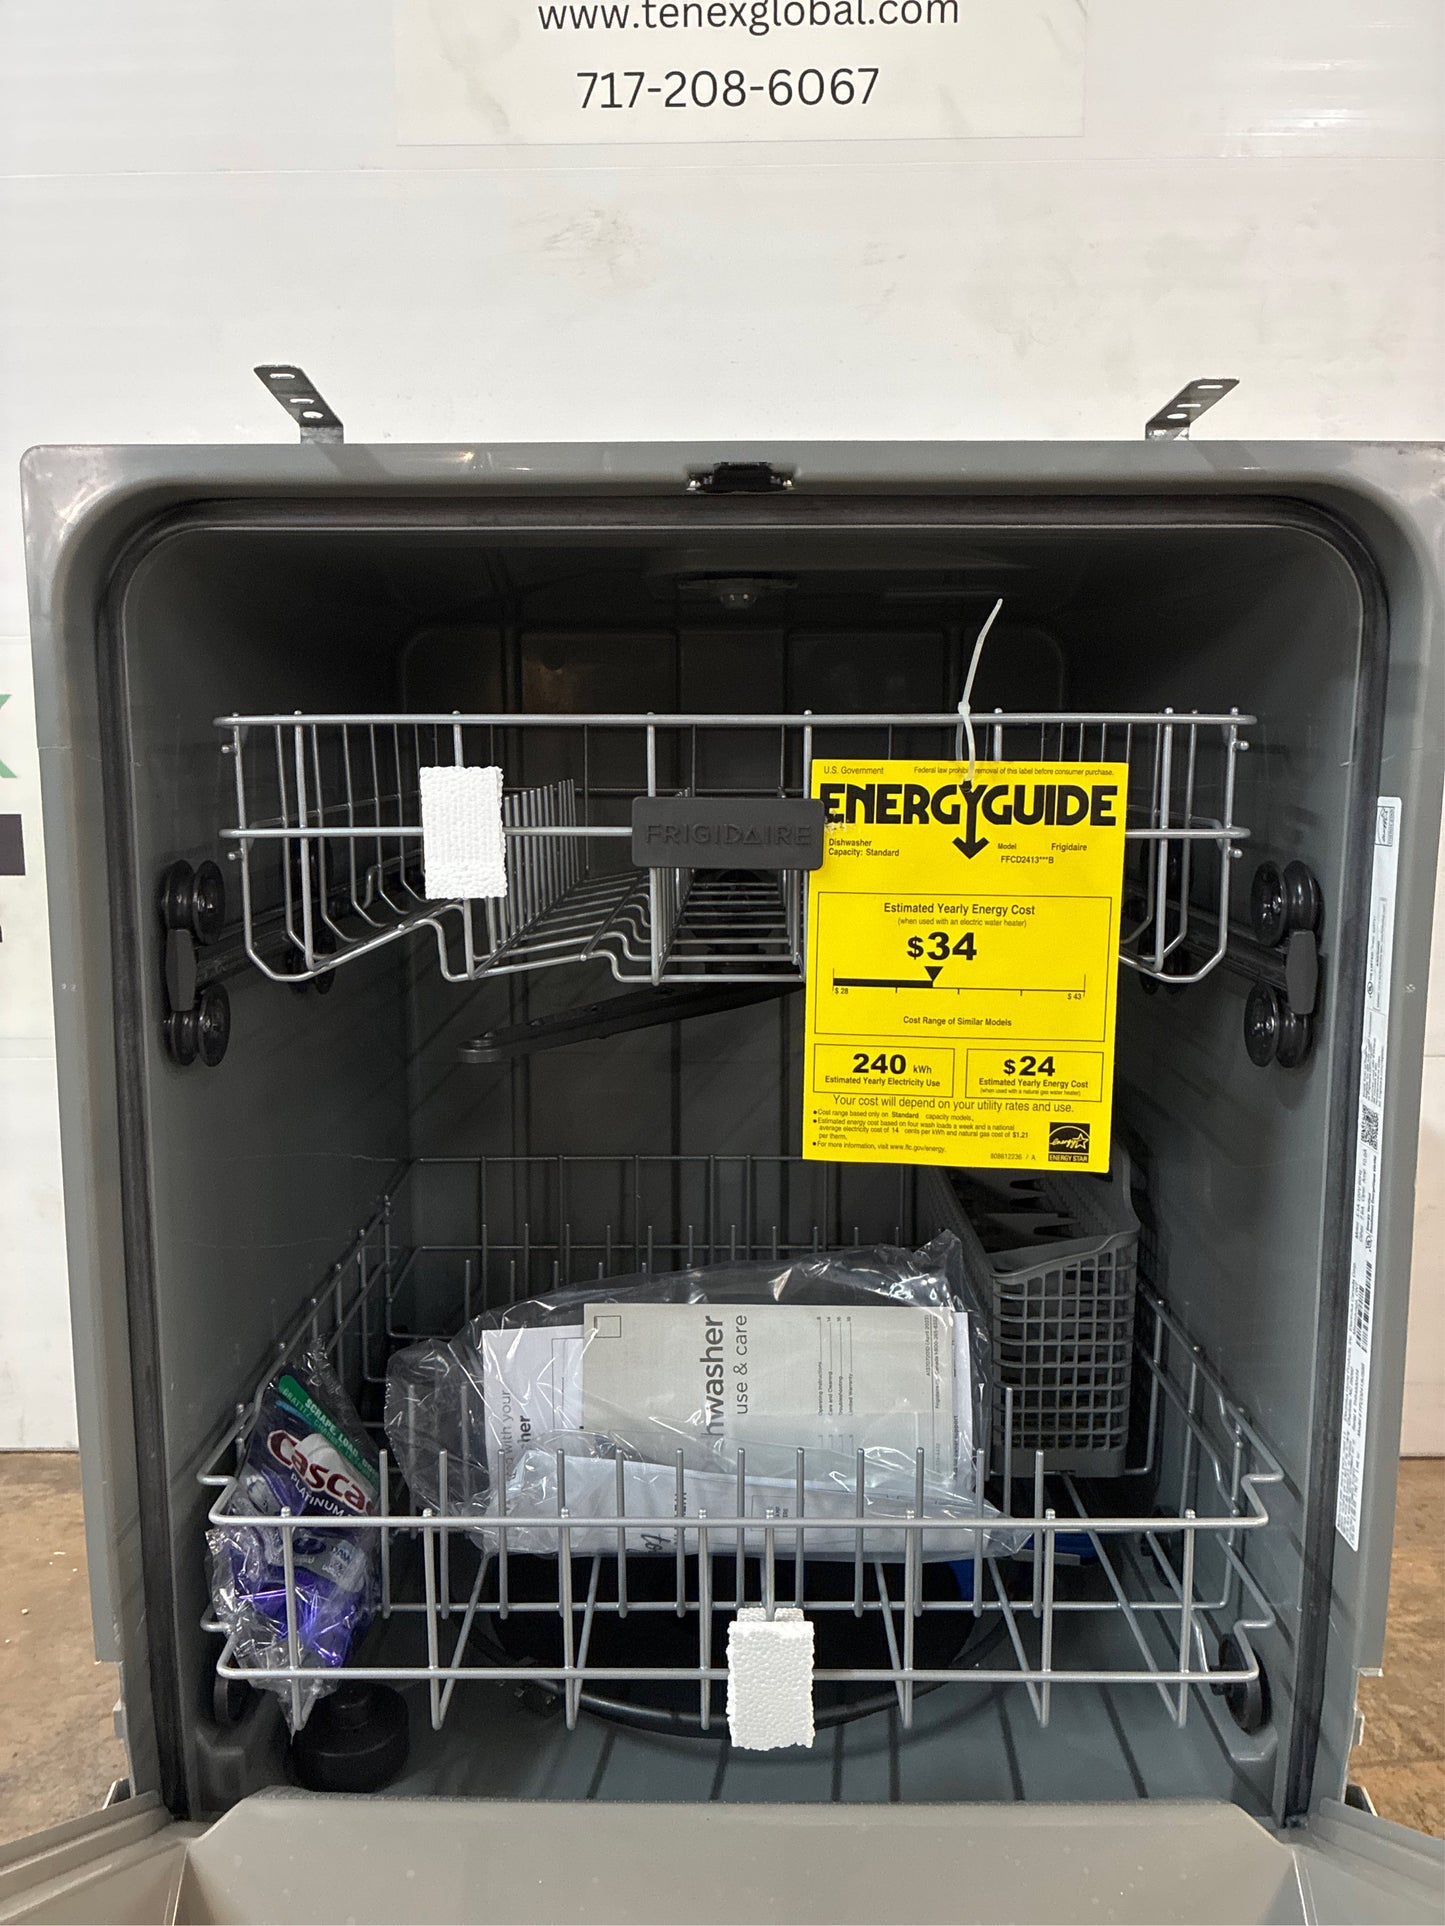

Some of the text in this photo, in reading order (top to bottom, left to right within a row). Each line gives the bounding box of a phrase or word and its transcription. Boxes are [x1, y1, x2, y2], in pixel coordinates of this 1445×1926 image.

[538, 0, 959, 36] www.tenexglobal.com
[576, 67, 880, 109] 717-208-6067
[823, 766, 884, 775] U.S. Government
[914, 766, 936, 774] Federal
[937, 766, 947, 774] law
[949, 766, 969, 776] prohibi
[1019, 767, 1033, 775] label
[646, 823, 812, 846] FRIGIDAIRE
[829, 838, 872, 847] Dishwasher
[829, 848, 900, 857] Capacity: Standard
[1051, 843, 1088, 853] Frigidaire
[884, 902, 1035, 917] Estimated Yearly Energy Cost
[898, 918, 917, 926] (when
[936, 918, 948, 926] with
[1003, 920, 1027, 928] heater)
[907, 931, 977, 960] $34
[903, 1015, 1012, 1026] Cost Range of Similar Models
[852, 1053, 932, 1074] 240 kWh
[1003, 1055, 1055, 1077] $24
[825, 1076, 861, 1084] Estimated
[864, 1077, 885, 1086] Yearly
[888, 1078, 924, 1087] Electricity
[979, 1078, 1088, 1089] Estimated Yearly Energy Cost
[833, 1095, 856, 1105] Your
[858, 1096, 879, 1106] cost
[881, 1097, 896, 1107] will
[899, 1098, 936, 1109] depend
[953, 1101, 974, 1111] your
[977, 1101, 1002, 1112] utility
[1005, 1102, 1030, 1111] rates
[1032, 1102, 1051, 1112] and
[1054, 1103, 1074, 1112] use.
[892, 1111, 919, 1119] Standard
[925, 1113, 949, 1121] capacity
[843, 1126, 869, 1134] electricity
[733, 1315, 748, 1415] use & care
[700, 1315, 724, 1436] hwasher
[502, 1390, 513, 1422] your
[501, 1427, 512, 1454] with
[268, 1430, 372, 1516] Casca
[290, 1472, 344, 1517] PLATINUM
